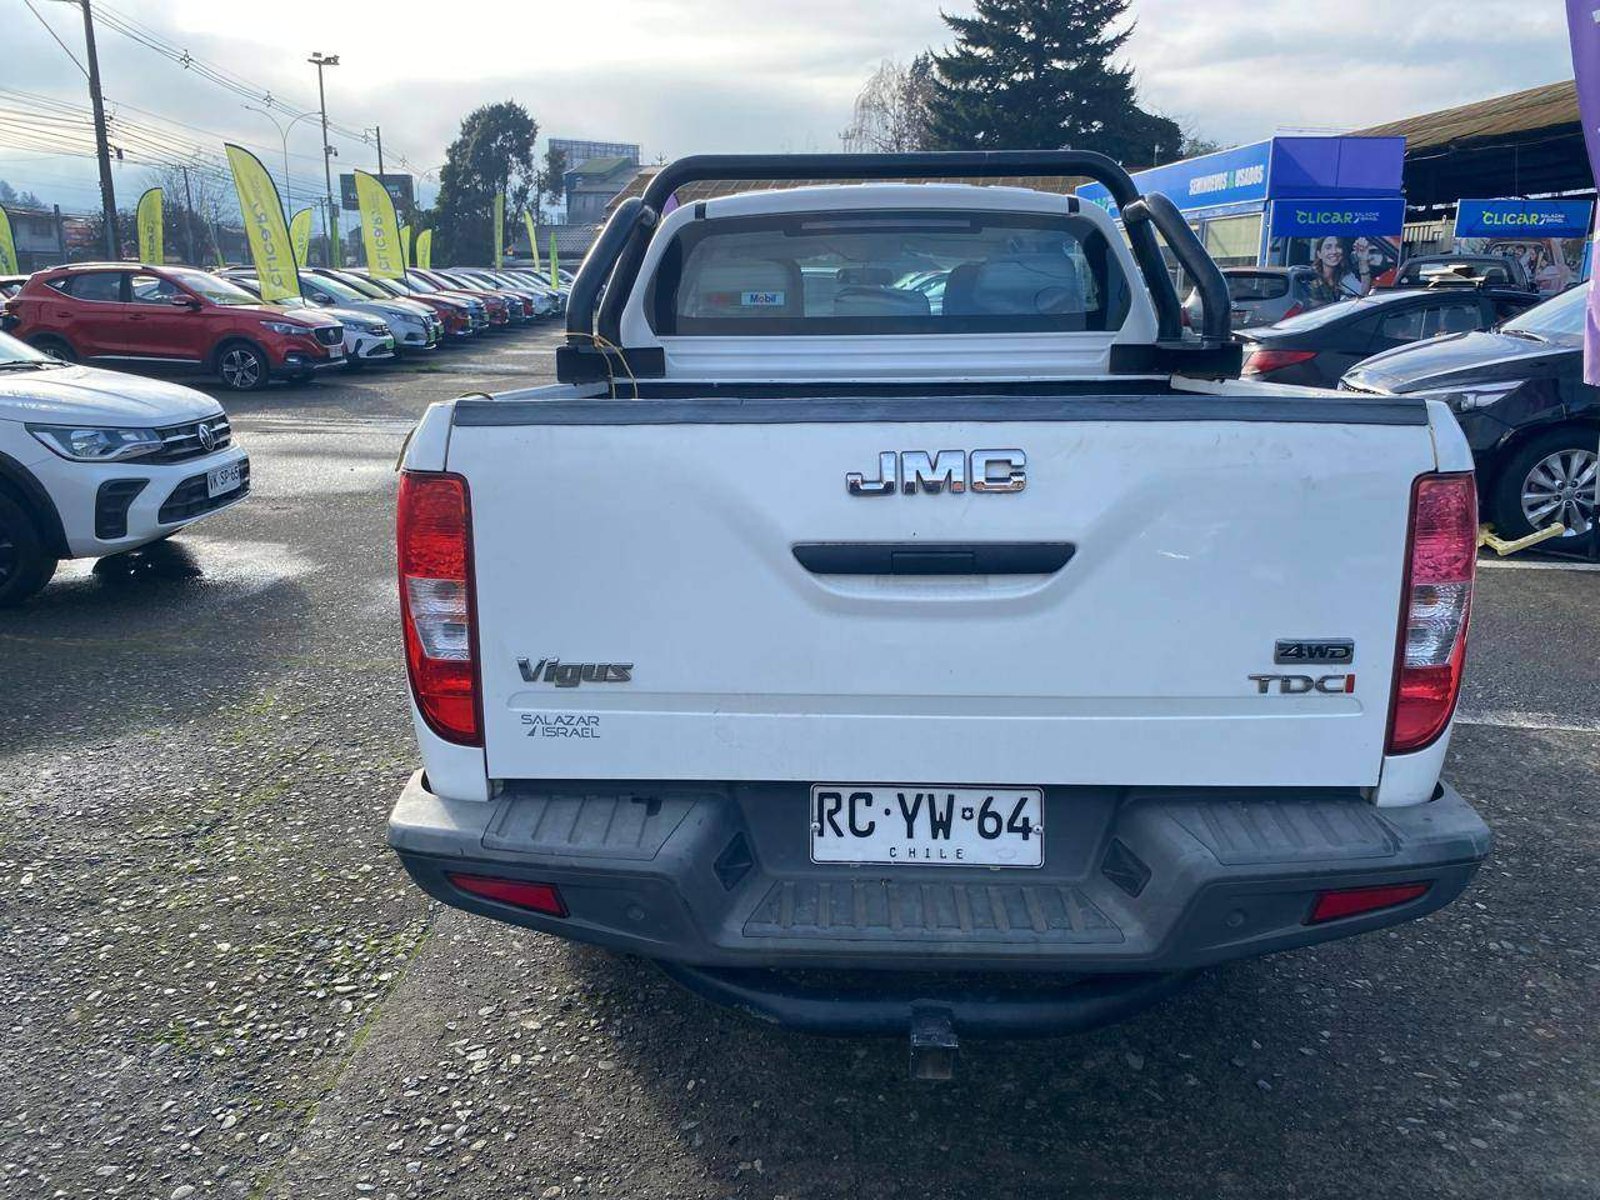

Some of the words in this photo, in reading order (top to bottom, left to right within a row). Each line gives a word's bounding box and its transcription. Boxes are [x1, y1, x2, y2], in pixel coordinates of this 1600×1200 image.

[750, 293, 777, 304] Mobil
[846, 448, 1026, 497] JMC
[1279, 642, 1352, 659] 4WD
[517, 657, 634, 688] Vigus
[521, 714, 600, 726] SALAZAR
[541, 726, 600, 738] ISRAEL
[889, 847, 964, 859] CHILE
